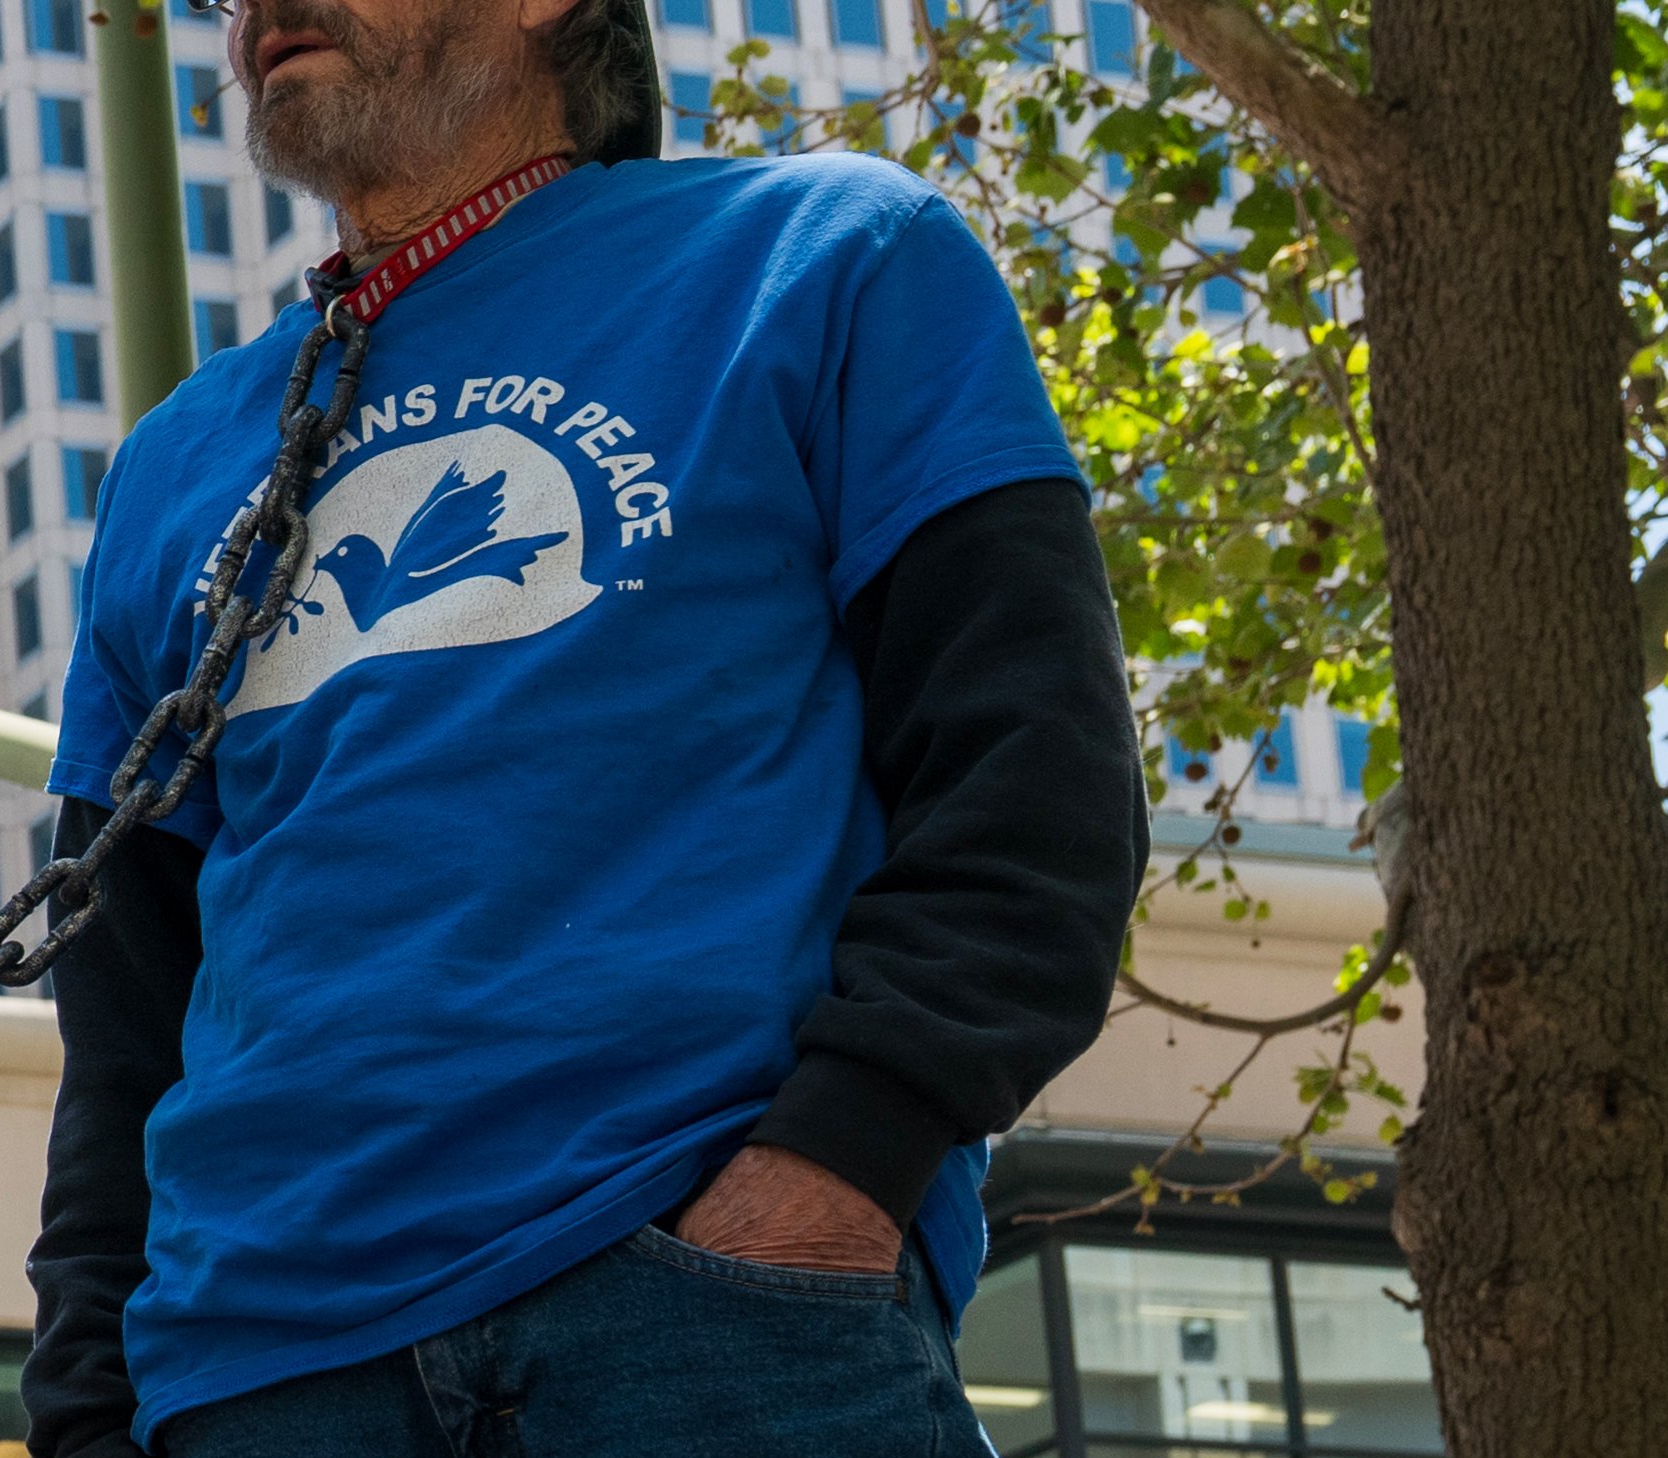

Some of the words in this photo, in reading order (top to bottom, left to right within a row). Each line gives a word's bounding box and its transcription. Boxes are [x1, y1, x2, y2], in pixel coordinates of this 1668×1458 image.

[453, 374, 566, 425] FOR
[553, 401, 673, 548] PEACE
[614, 578, 644, 591] TM
